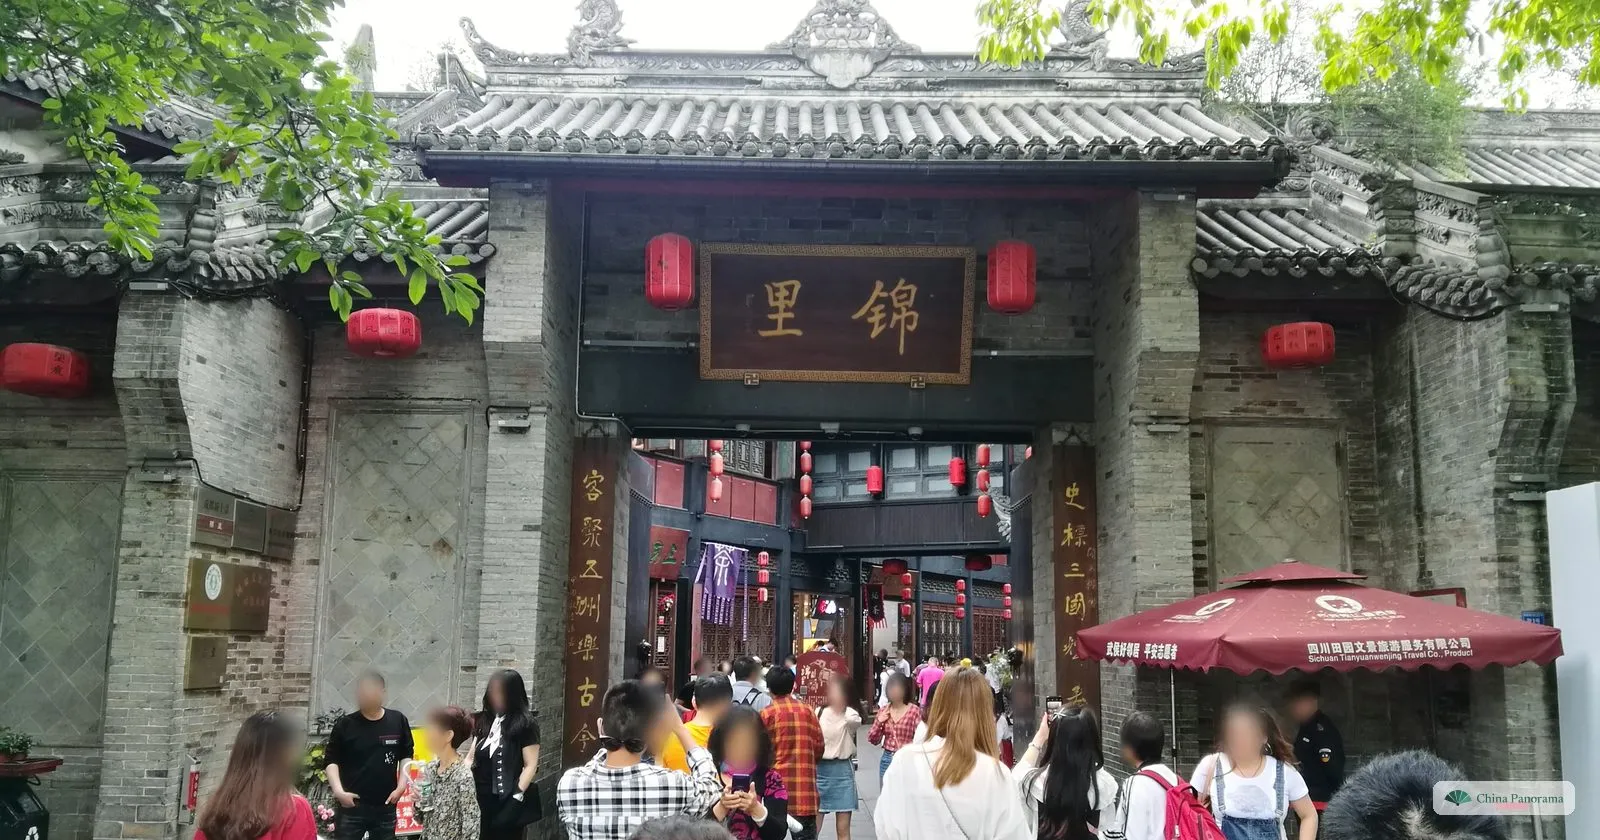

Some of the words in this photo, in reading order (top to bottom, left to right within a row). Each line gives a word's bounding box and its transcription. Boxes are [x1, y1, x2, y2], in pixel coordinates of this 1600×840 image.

[1106, 641, 1140, 658] 武侯好邻居
[1144, 643, 1178, 660] 平安志愿者
[1307, 637, 1472, 654] 四川田园文景旅游服务有限公司
[1308, 654, 1339, 663] Sichuan
[1340, 651, 1402, 662] Tianyuanwenjing
[1403, 650, 1427, 659] Travel
[1444, 648, 1473, 658] Product
